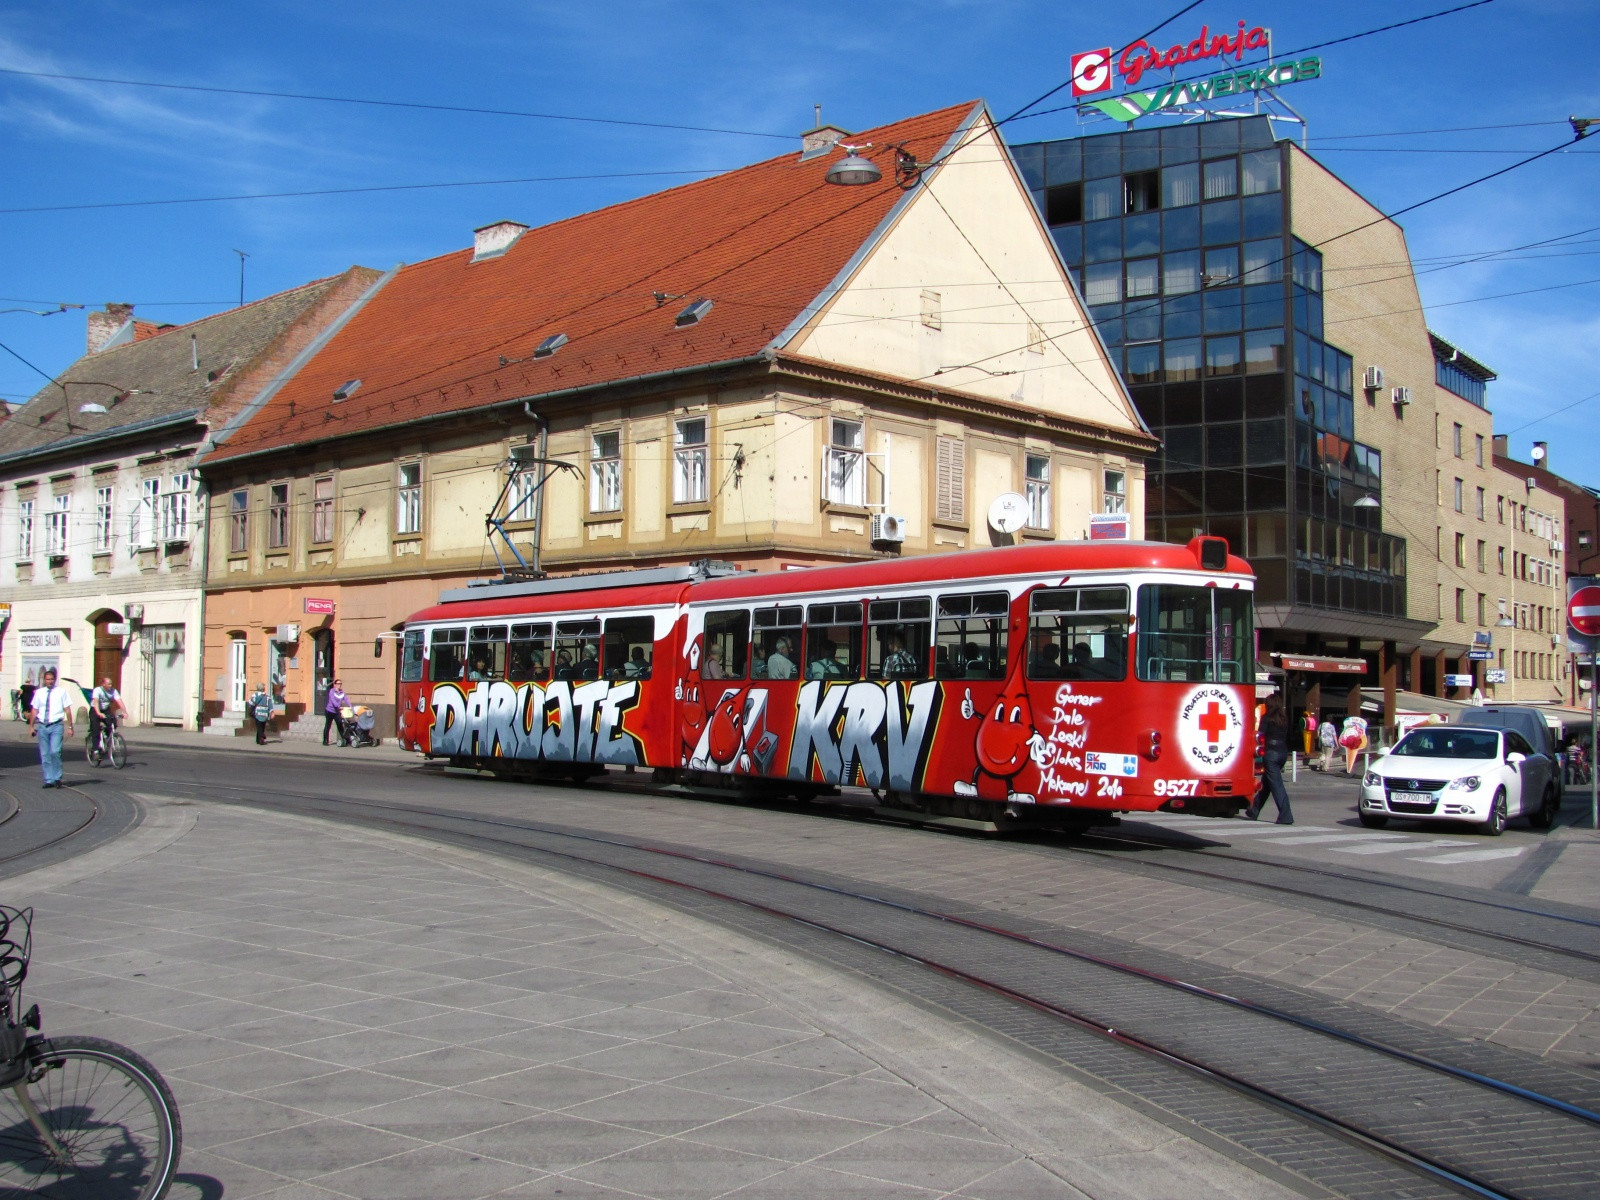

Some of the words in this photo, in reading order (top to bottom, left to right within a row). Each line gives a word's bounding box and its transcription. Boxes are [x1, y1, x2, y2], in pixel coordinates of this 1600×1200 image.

[1118, 20, 1269, 85] Gradnja
[1185, 56, 1321, 101] WERKOS
[45, 635, 60, 647] SALON
[430, 679, 643, 767] DARUJTE
[787, 678, 943, 791] KRV
[1052, 706, 1085, 726] Dale
[1153, 779, 1200, 796] 9527
